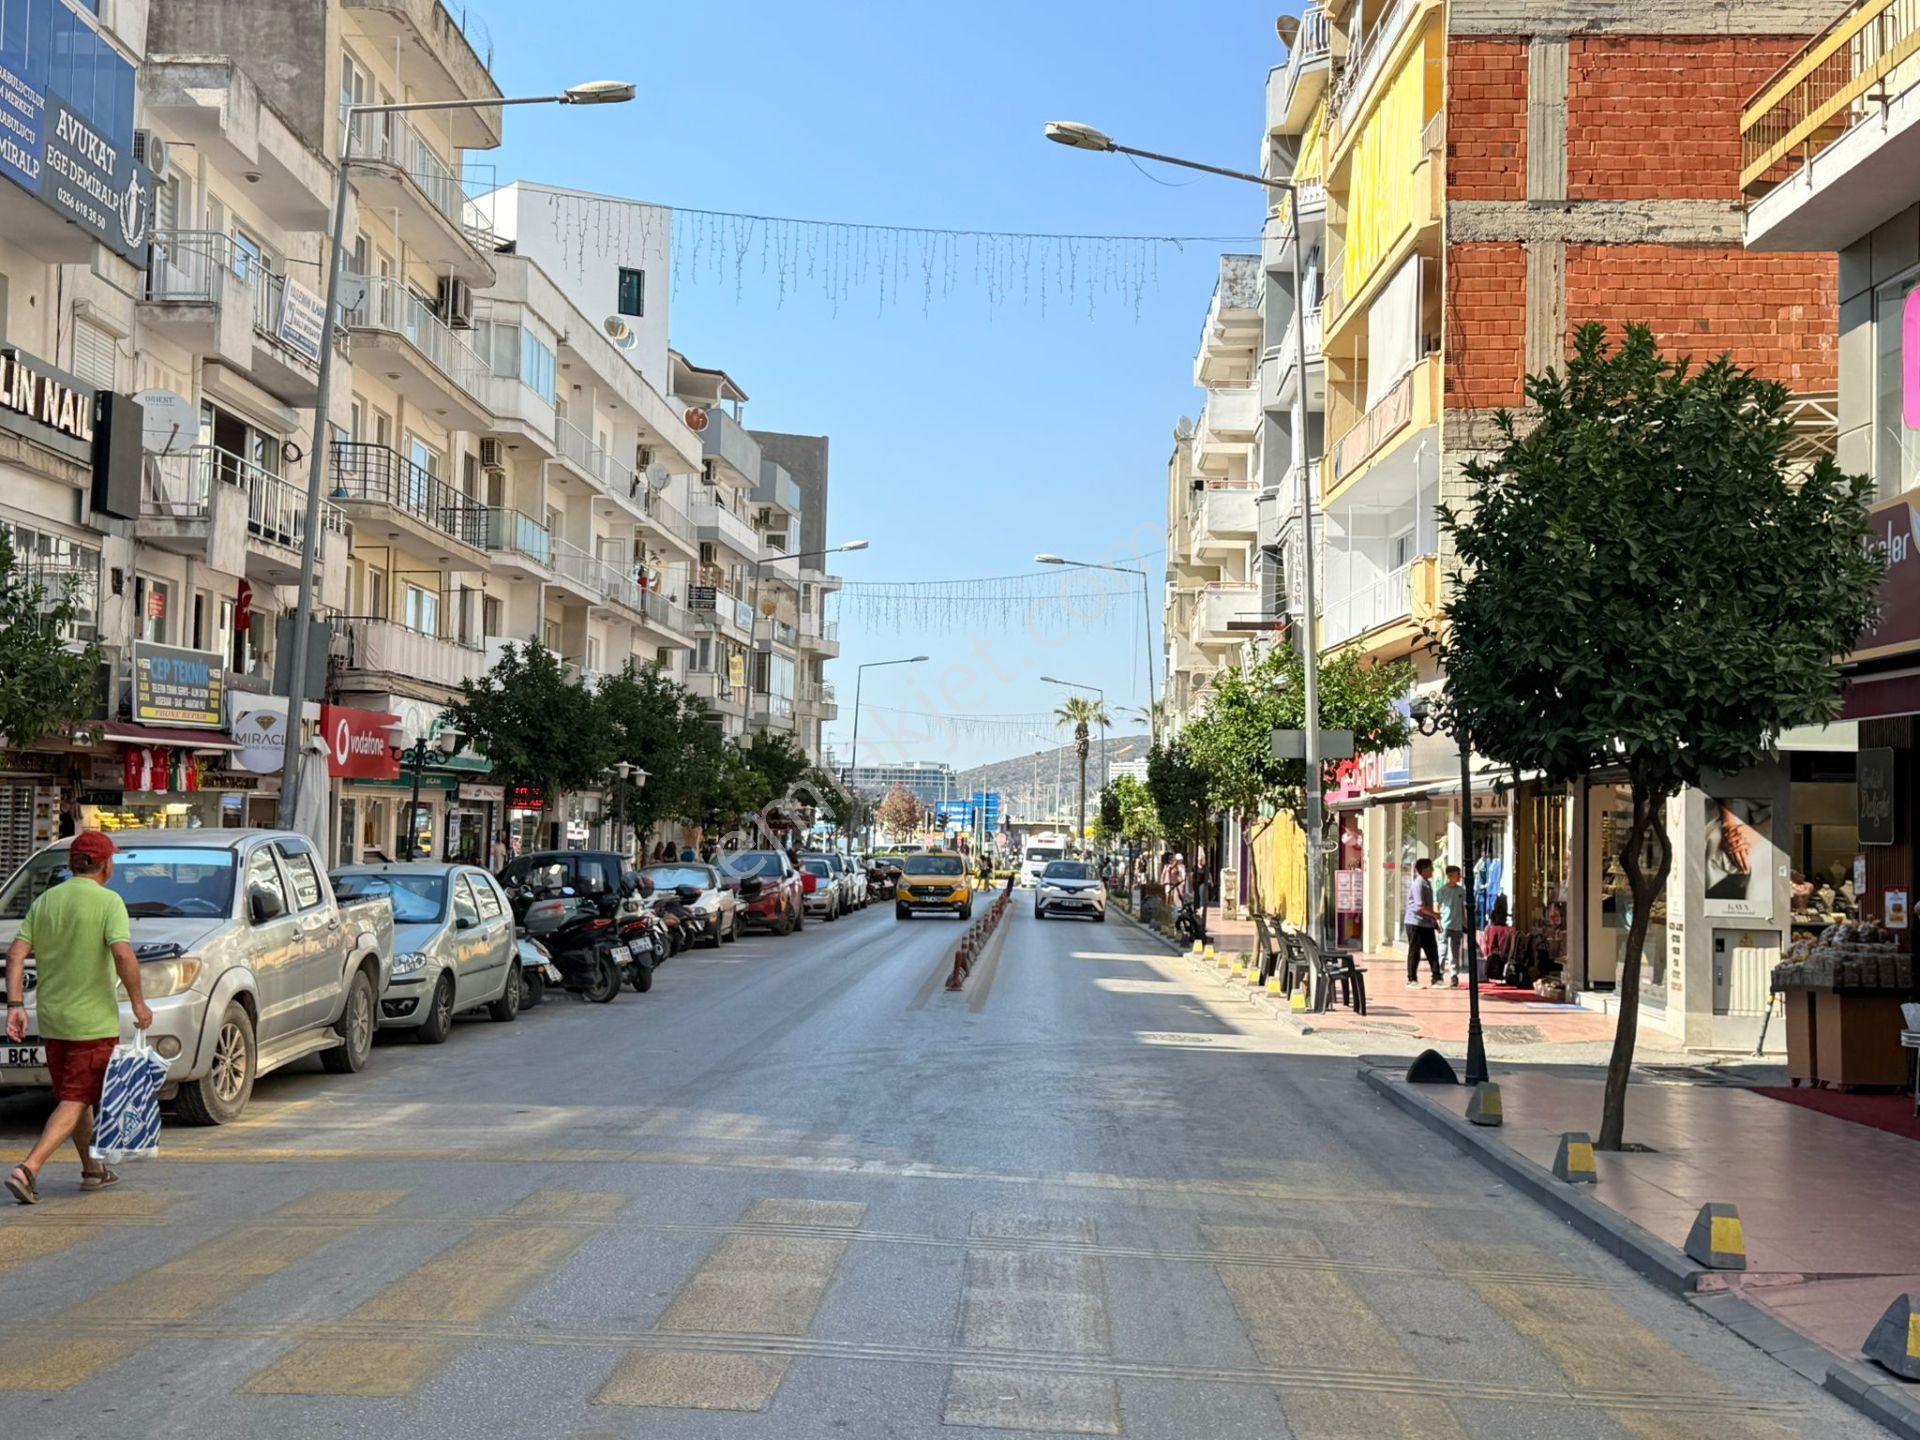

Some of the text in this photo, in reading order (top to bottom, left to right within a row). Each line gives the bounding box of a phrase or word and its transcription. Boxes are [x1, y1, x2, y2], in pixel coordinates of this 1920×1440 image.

[56, 109, 117, 176] AVUKAT
[46, 143, 120, 212] EGE DEMİRALP
[57, 187, 106, 230] 0256 618 35 50
[42, 376, 93, 443] NAIL
[145, 395, 175, 404] ORIENT
[150, 655, 170, 681] CEP
[173, 657, 209, 688] TEKNİK
[351, 729, 384, 756] vodafone
[8, 1048, 39, 1063] BCK
